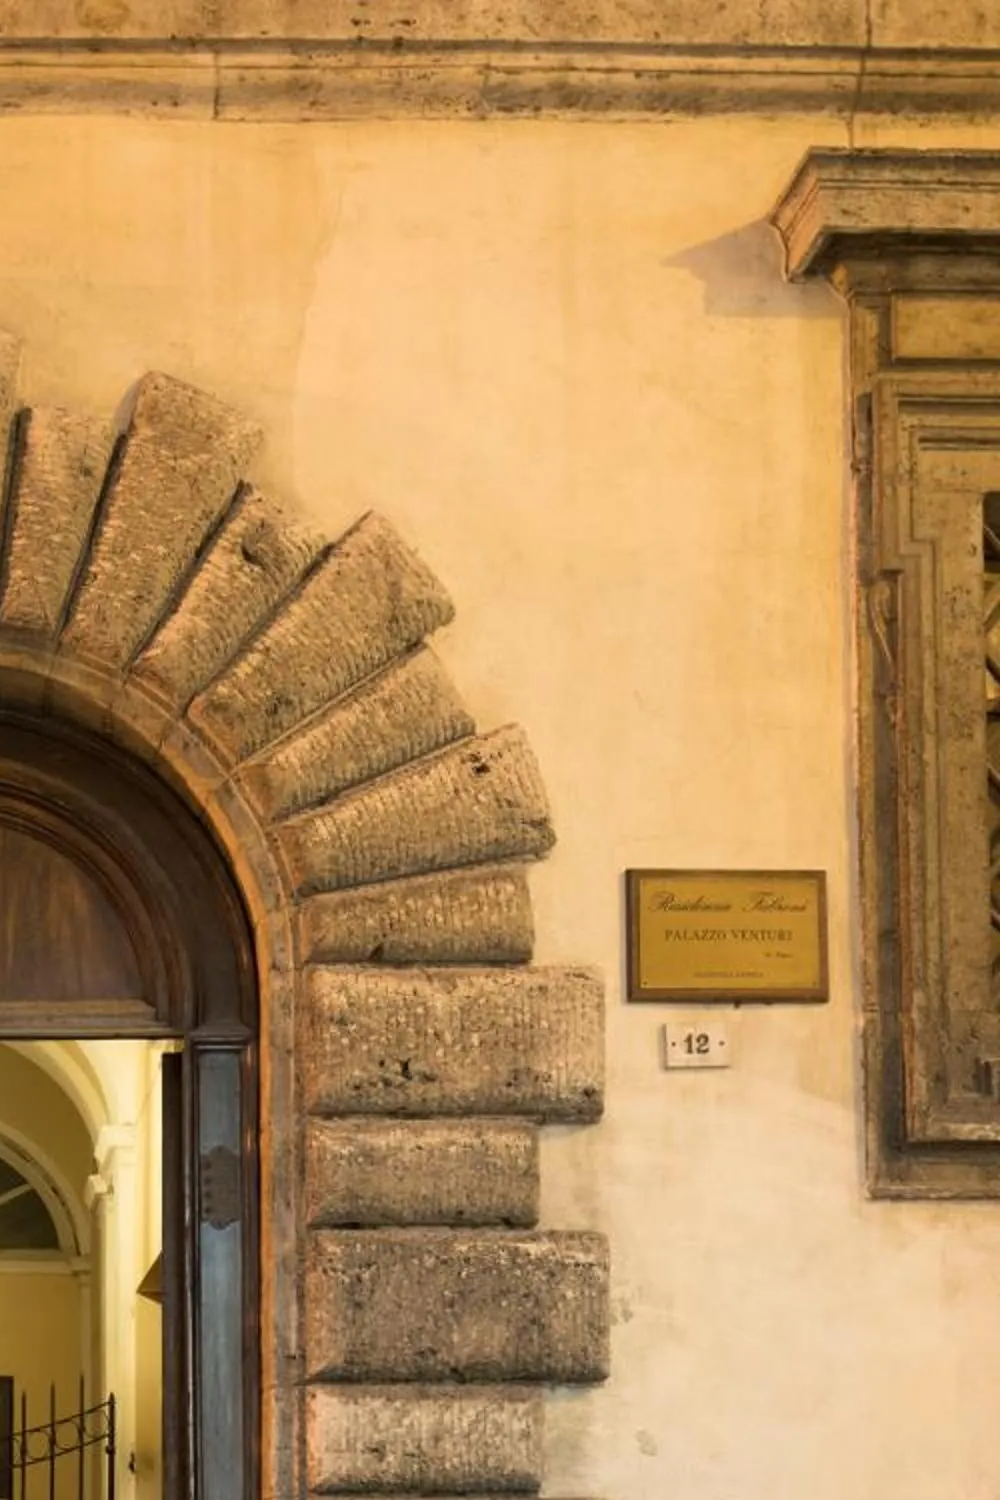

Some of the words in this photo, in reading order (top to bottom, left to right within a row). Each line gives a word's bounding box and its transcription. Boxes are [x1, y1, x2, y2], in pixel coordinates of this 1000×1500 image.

[664, 929, 726, 942] PALAZZO
[731, 929, 793, 942] VENTURI
[684, 1033, 710, 1055] 12
